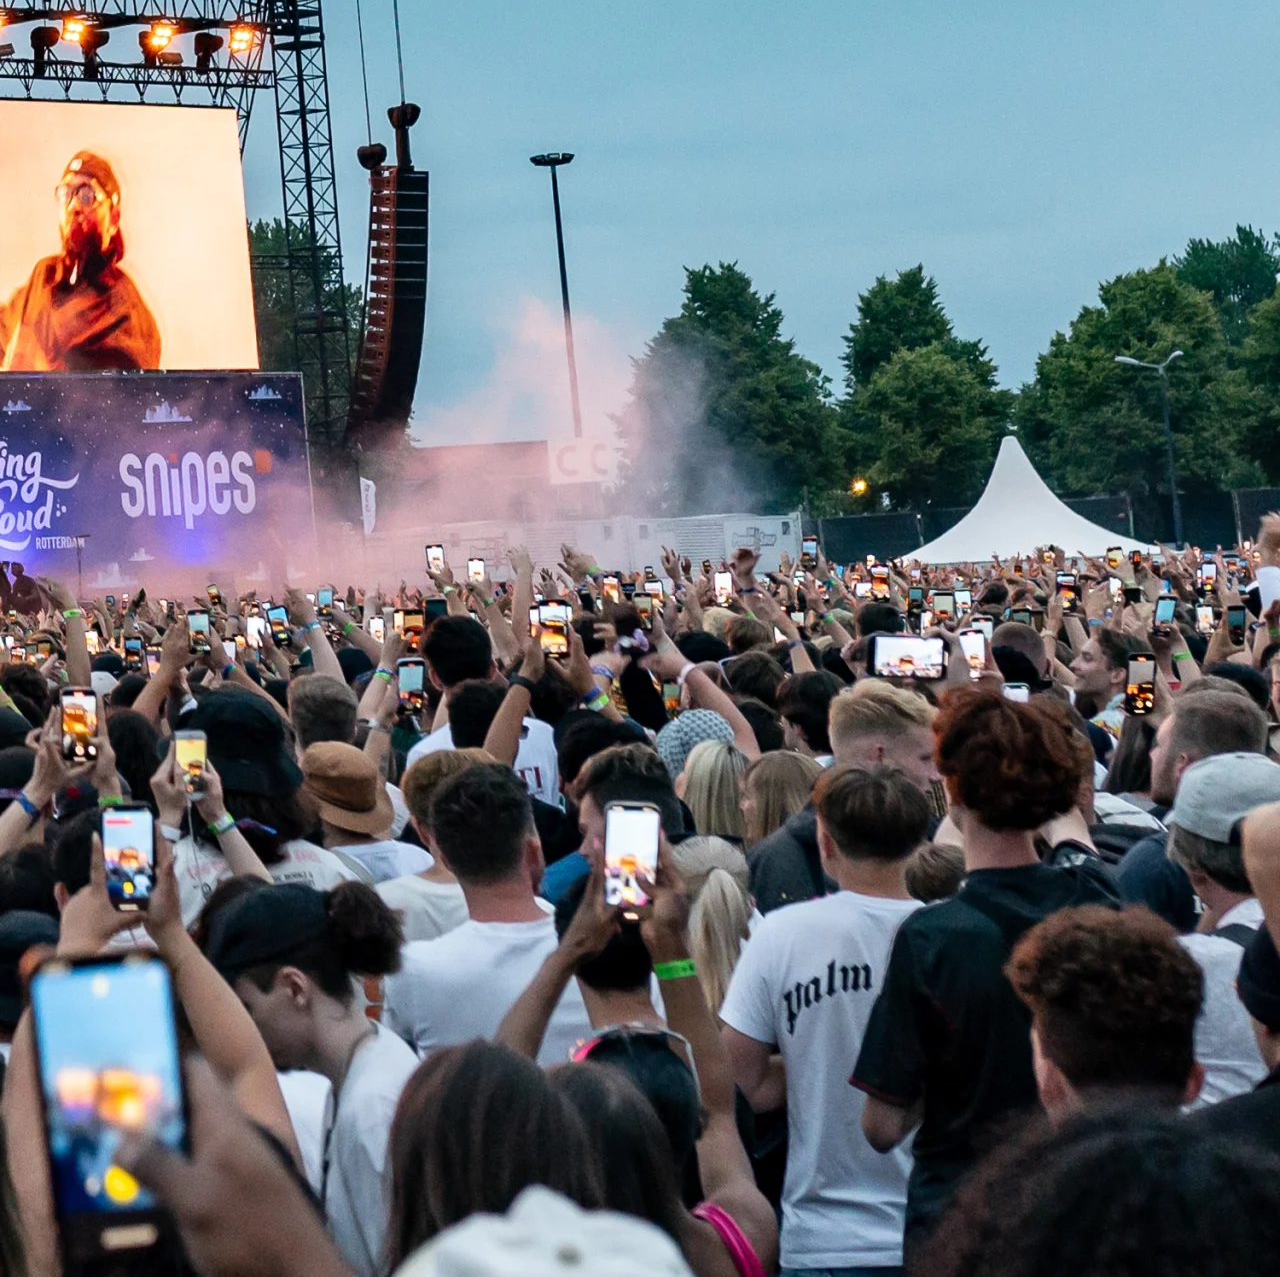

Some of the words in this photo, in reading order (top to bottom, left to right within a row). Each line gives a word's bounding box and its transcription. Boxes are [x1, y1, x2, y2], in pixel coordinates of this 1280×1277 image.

[119, 450, 256, 530] snipes
[35, 536, 85, 550] ROTTERDAM
[783, 958, 872, 1037] palm
